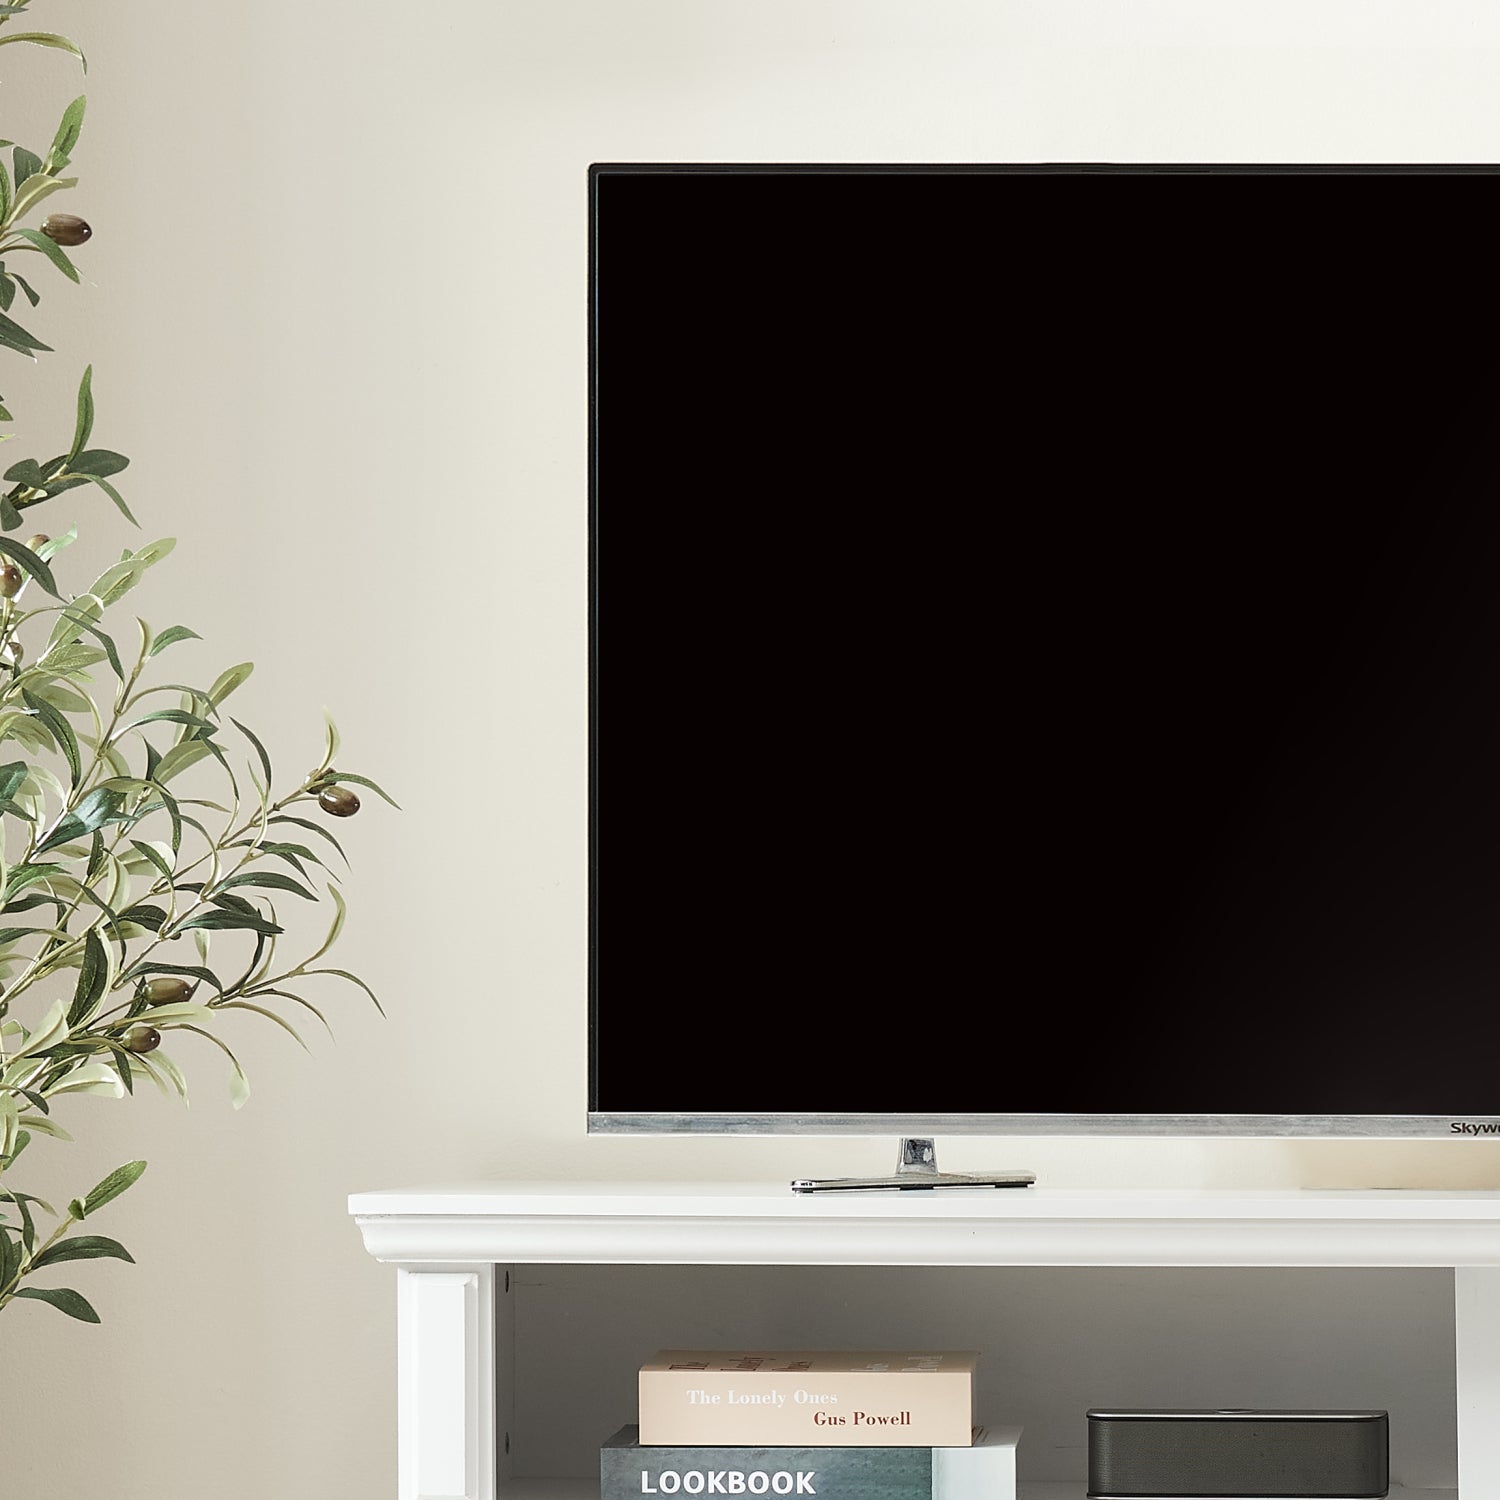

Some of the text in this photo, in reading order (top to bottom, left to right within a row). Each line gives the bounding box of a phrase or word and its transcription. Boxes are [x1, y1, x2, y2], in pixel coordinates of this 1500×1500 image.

[686, 1389, 838, 1408] The Lonely Ones
[813, 1411, 912, 1426] Gus Powell
[640, 1470, 817, 1495] LOOKBOOK
